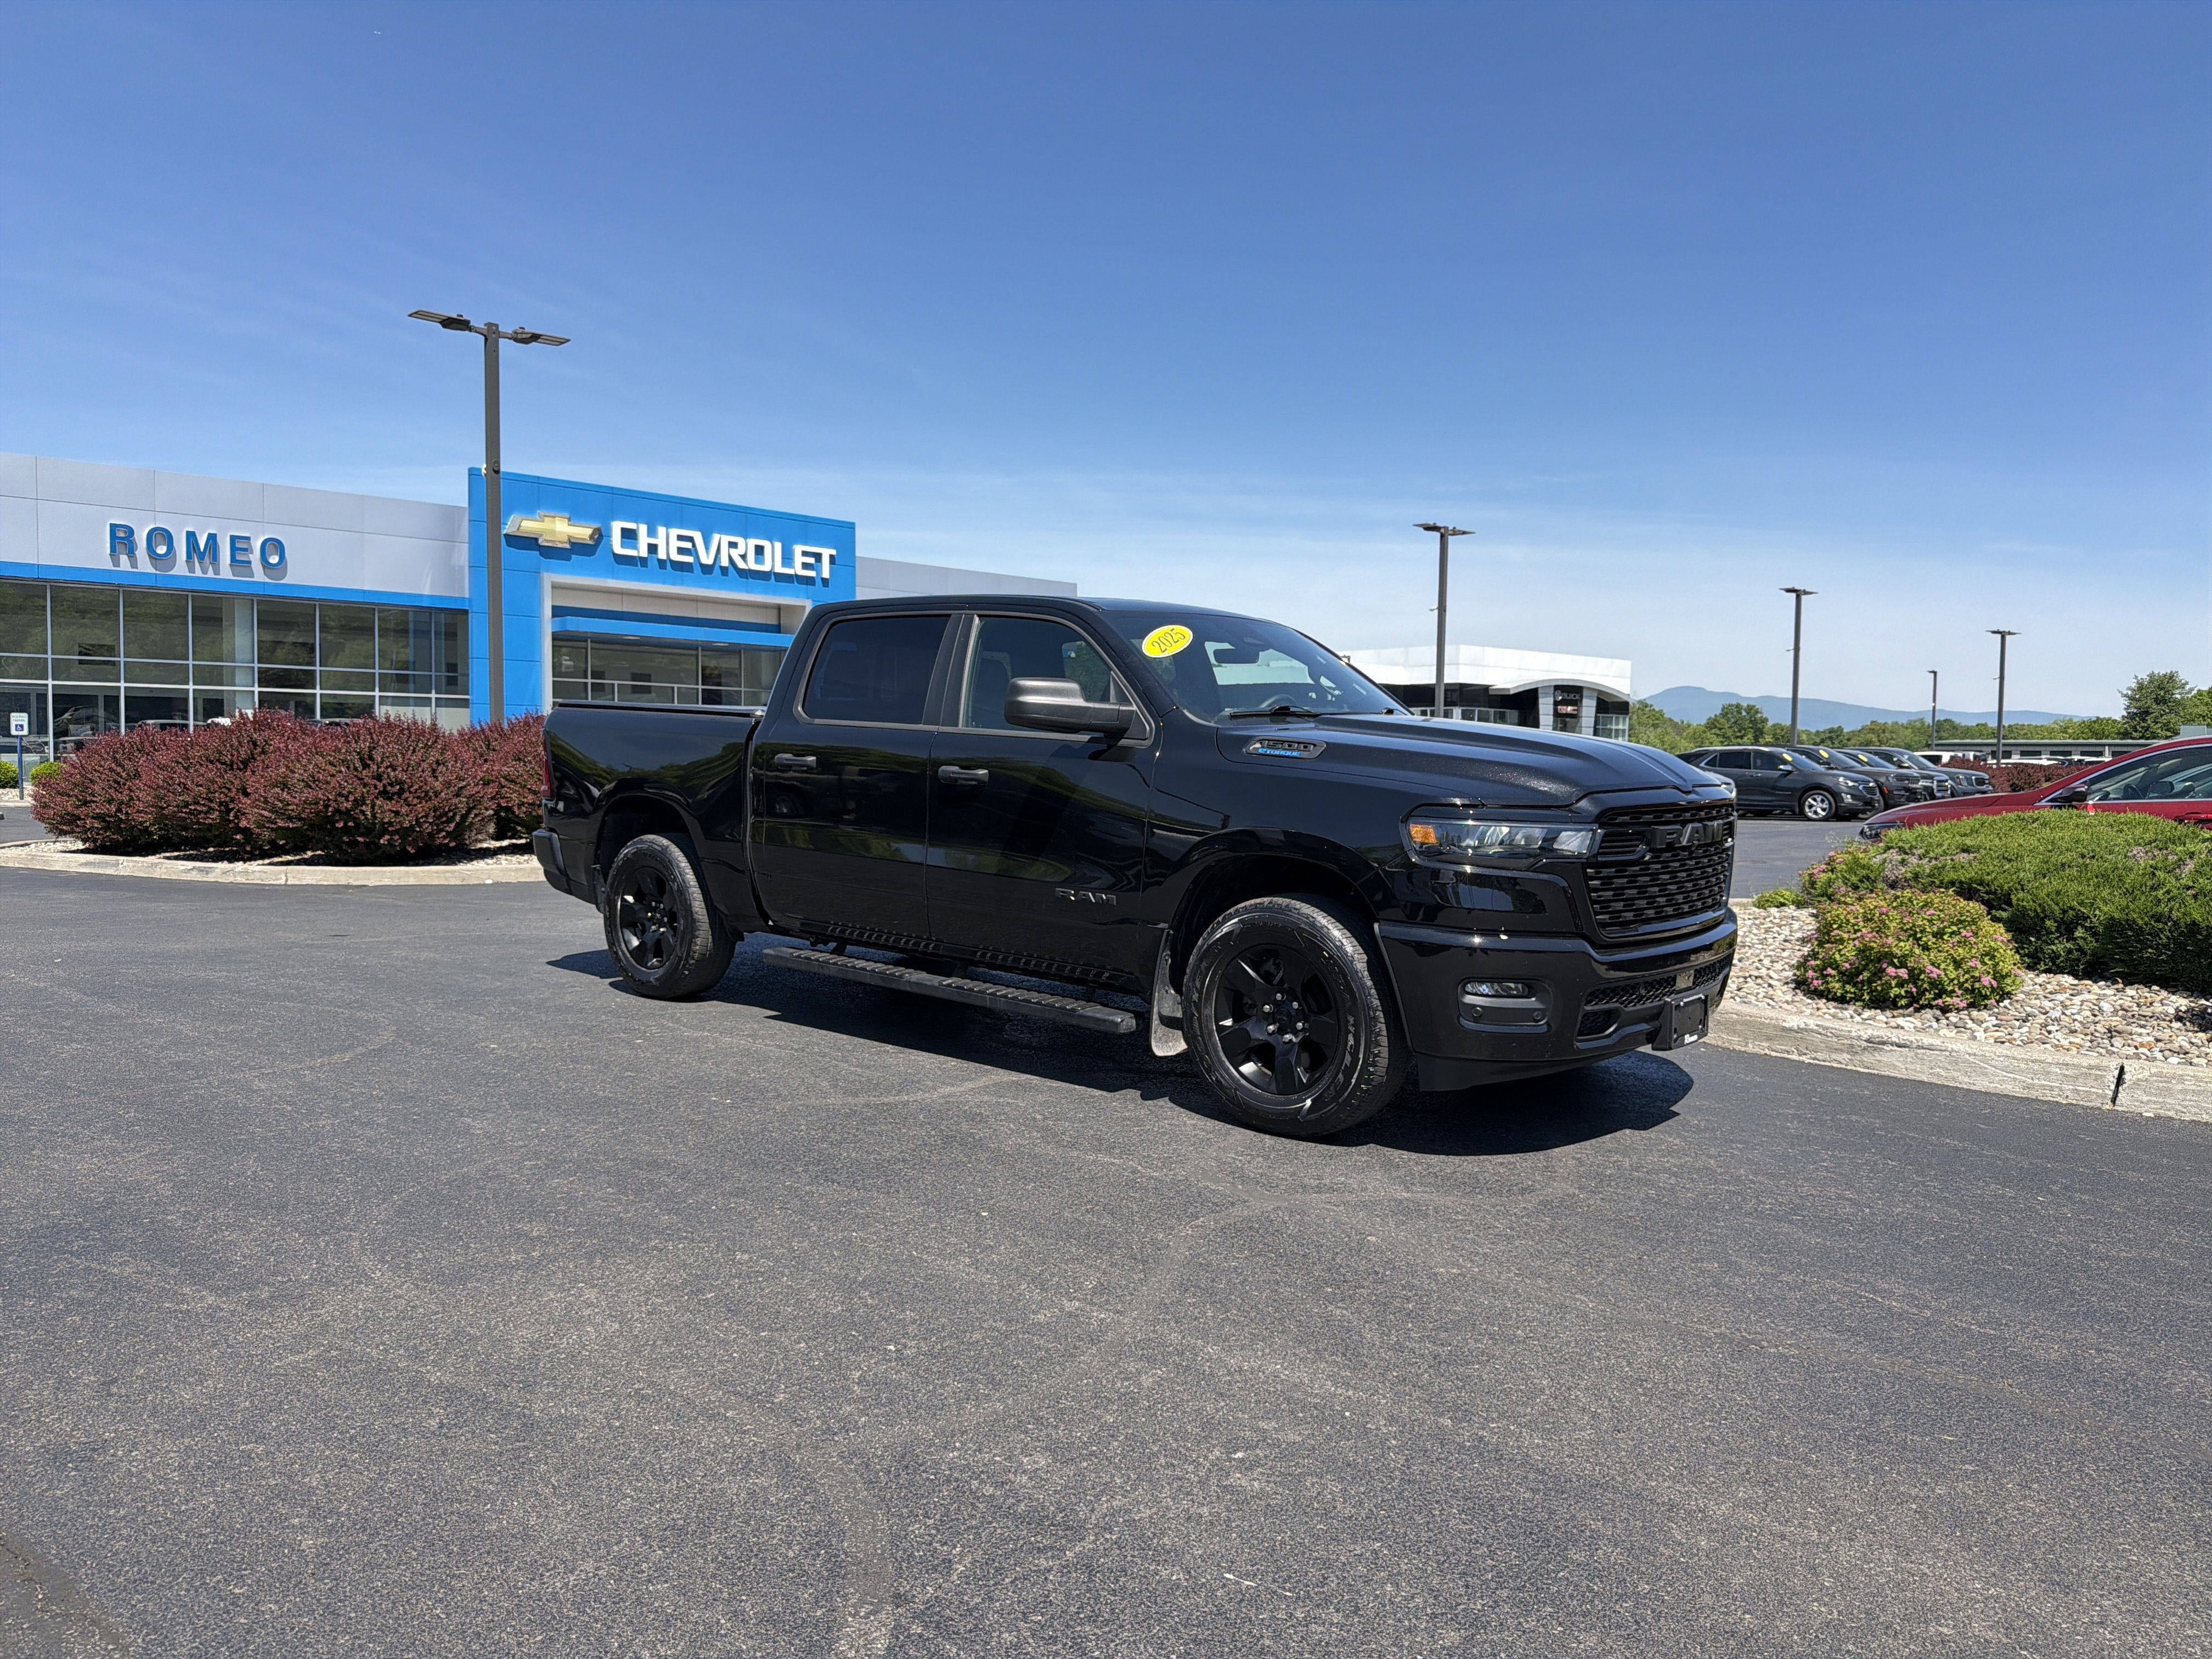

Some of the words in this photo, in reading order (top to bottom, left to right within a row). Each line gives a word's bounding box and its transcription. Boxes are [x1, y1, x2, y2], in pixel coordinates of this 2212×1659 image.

[109, 523, 286, 568] ROMEO
[612, 521, 837, 579] CHEVROLET
[1152, 628, 1186, 653] 2025
[1251, 740, 1314, 752] 1500
[1651, 820, 1723, 849] RAM
[1054, 888, 1116, 905] RAM
